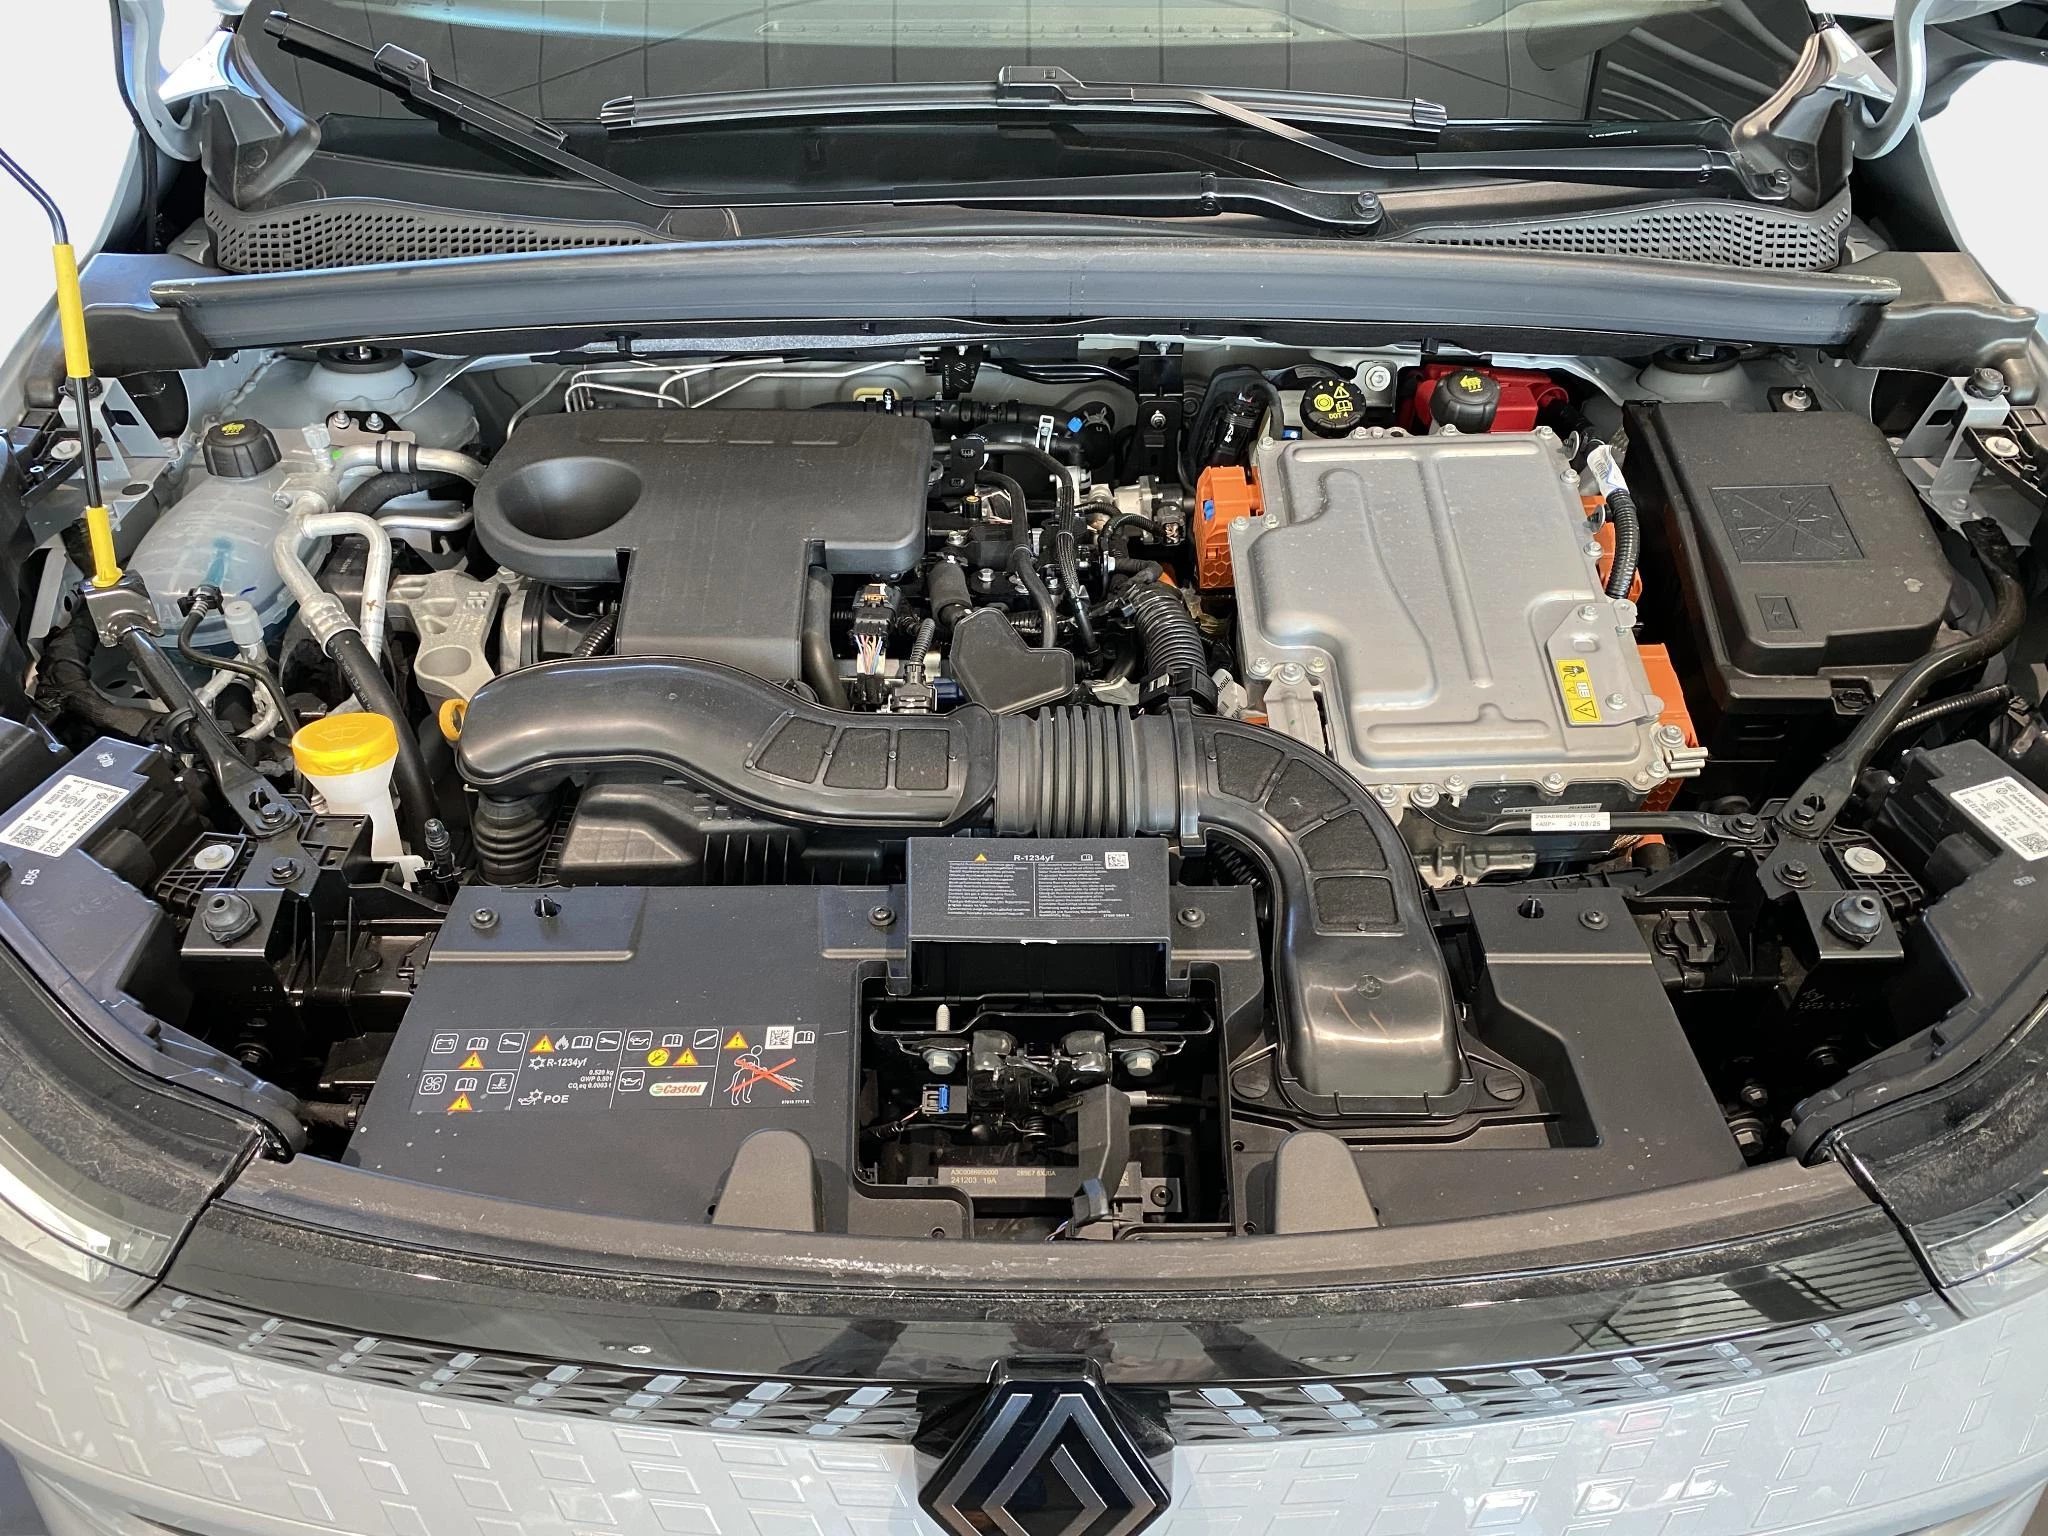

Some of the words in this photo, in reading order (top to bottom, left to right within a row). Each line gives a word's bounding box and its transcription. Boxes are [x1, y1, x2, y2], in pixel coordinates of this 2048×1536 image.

[1013, 854, 1054, 863] R-1234yf
[546, 1057, 588, 1068] R-1234yf
[663, 1084, 702, 1094] Castrol
[543, 1094, 570, 1104] POE
